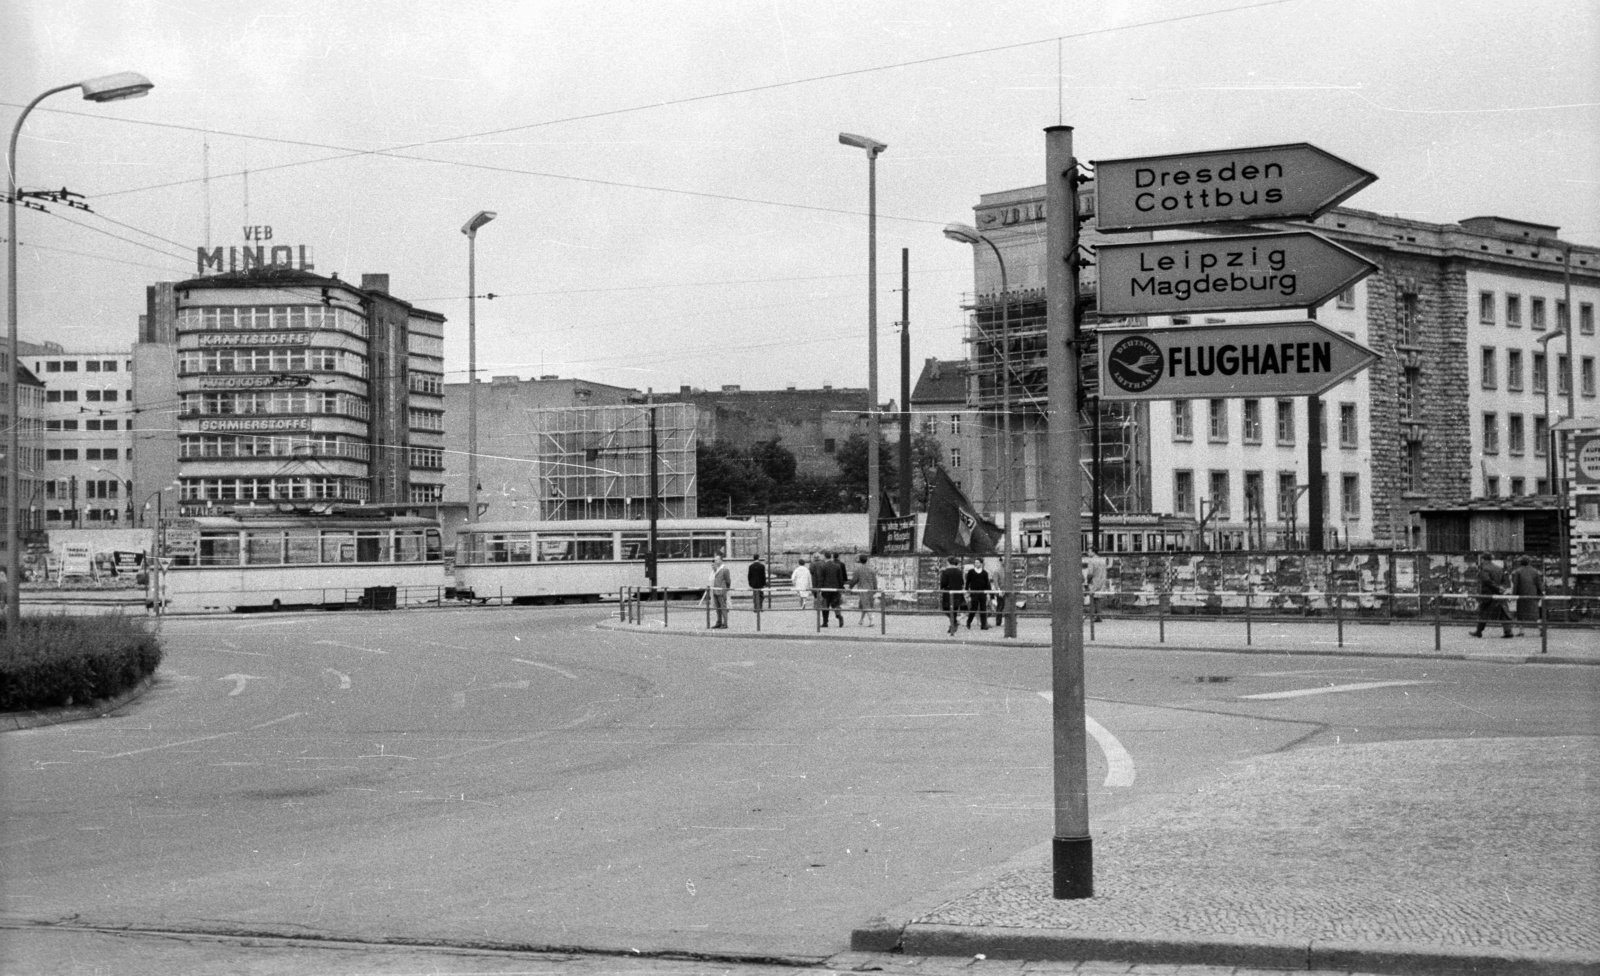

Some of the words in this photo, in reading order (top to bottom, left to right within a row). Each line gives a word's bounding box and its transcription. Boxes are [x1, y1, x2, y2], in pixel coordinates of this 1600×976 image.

[1135, 161, 1283, 188] Dresden
[1135, 188, 1283, 212] Cottbus
[243, 226, 273, 241] VEB
[197, 245, 315, 272] MINOL
[1139, 246, 1286, 273] Leipzig
[1131, 272, 1297, 300] Magdeburg
[203, 333, 305, 345] KRAFTSTOFFE
[1115, 340, 1158, 354] DEUTSCHE
[1168, 341, 1331, 377] FLUGHAFEN
[1113, 369, 1160, 389] LUFTHANSA
[201, 419, 307, 431] SCHMIERSTOFFE
